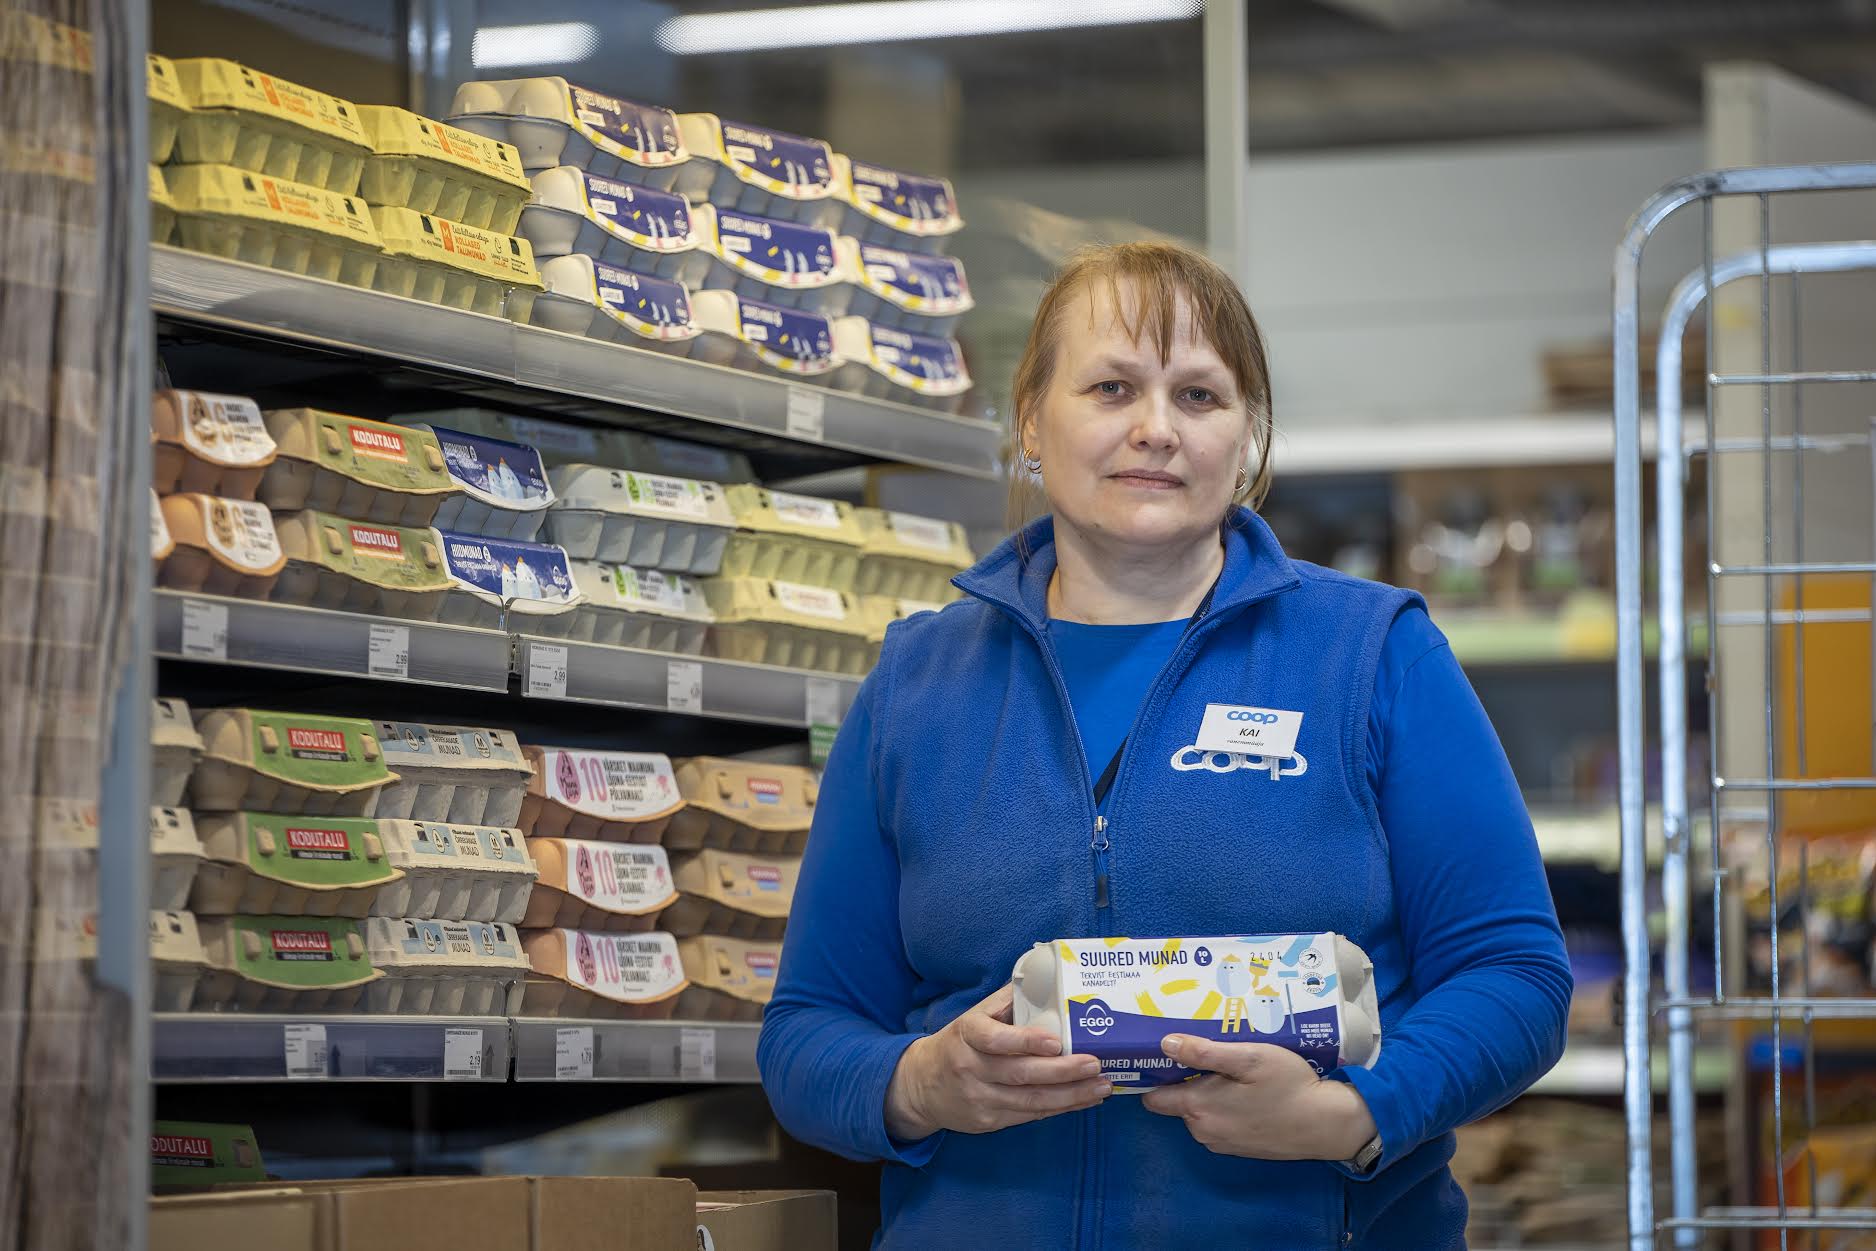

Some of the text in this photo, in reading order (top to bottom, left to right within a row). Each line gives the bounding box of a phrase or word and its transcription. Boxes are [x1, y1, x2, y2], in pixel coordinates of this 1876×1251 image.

[352, 429, 401, 451] KODUTALU
[352, 529, 399, 548] KODUTALU
[554, 670, 566, 681] 2.99
[1226, 710, 1279, 725] coop
[290, 730, 343, 749] KODUTALU
[1239, 728, 1261, 738] KAI
[580, 757, 608, 802] 10
[290, 831, 346, 849] KODUTALU
[594, 849, 617, 897] 10
[274, 933, 328, 949] KODUTALU
[597, 937, 620, 984] 10
[1080, 950, 1188, 967] SUURED MUNAD
[1080, 971, 1105, 980] TERVIST
[1079, 1017, 1115, 1028] EGGO
[1099, 1057, 1173, 1070] URED MUNAD
[151, 1137, 208, 1155] ODUTALU
